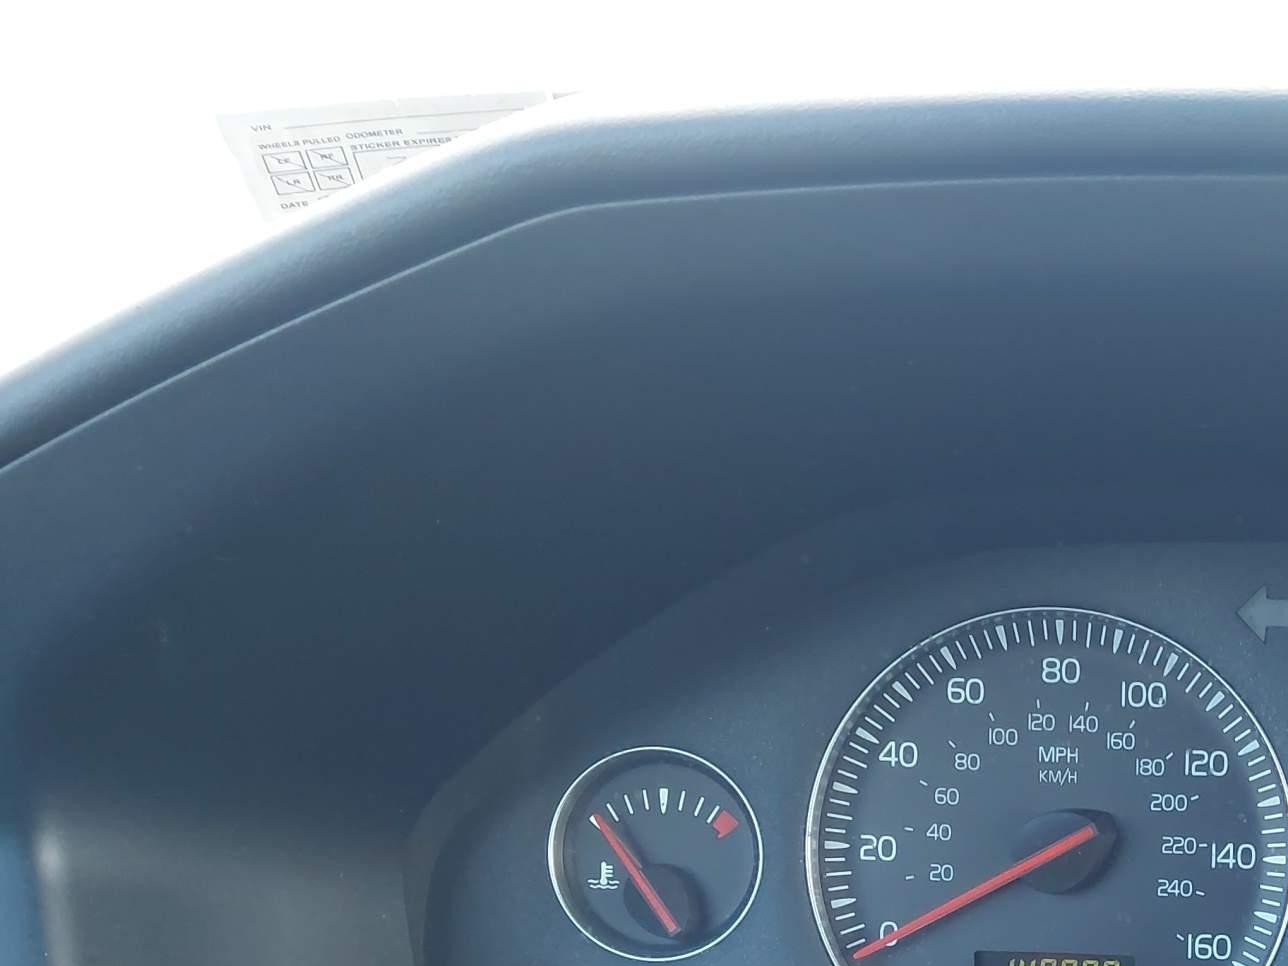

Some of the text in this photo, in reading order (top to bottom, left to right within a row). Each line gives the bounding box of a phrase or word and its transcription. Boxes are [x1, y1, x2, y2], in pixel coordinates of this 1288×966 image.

[250, 124, 272, 132] VIN
[345, 128, 403, 139] ODOMETER
[257, 136, 341, 150] WHEELS PULLED
[350, 141, 400, 151] STICKER
[280, 201, 309, 210] DATE
[1042, 658, 1081, 683] 80
[947, 678, 984, 704] 60
[1120, 681, 1167, 708] 100
[1027, 714, 1055, 731] 120
[1069, 716, 1098, 733] 140
[988, 728, 1018, 746] 100
[1107, 733, 1135, 750] 160
[879, 742, 918, 768] 40
[955, 752, 980, 770] 80
[1038, 747, 1079, 764] MPH
[1184, 750, 1229, 776] 120
[1136, 758, 1164, 776] 180
[1038, 768, 1078, 785] KM/H
[934, 787, 960, 805] 60
[1150, 794, 1188, 812] 200
[926, 824, 951, 840] 40
[860, 835, 896, 861] 20
[1162, 837, 1196, 854] 220
[1210, 843, 1256, 869] 140
[929, 864, 954, 881] 20
[1157, 880, 1192, 897] 240
[1186, 934, 1231, 960] 160
